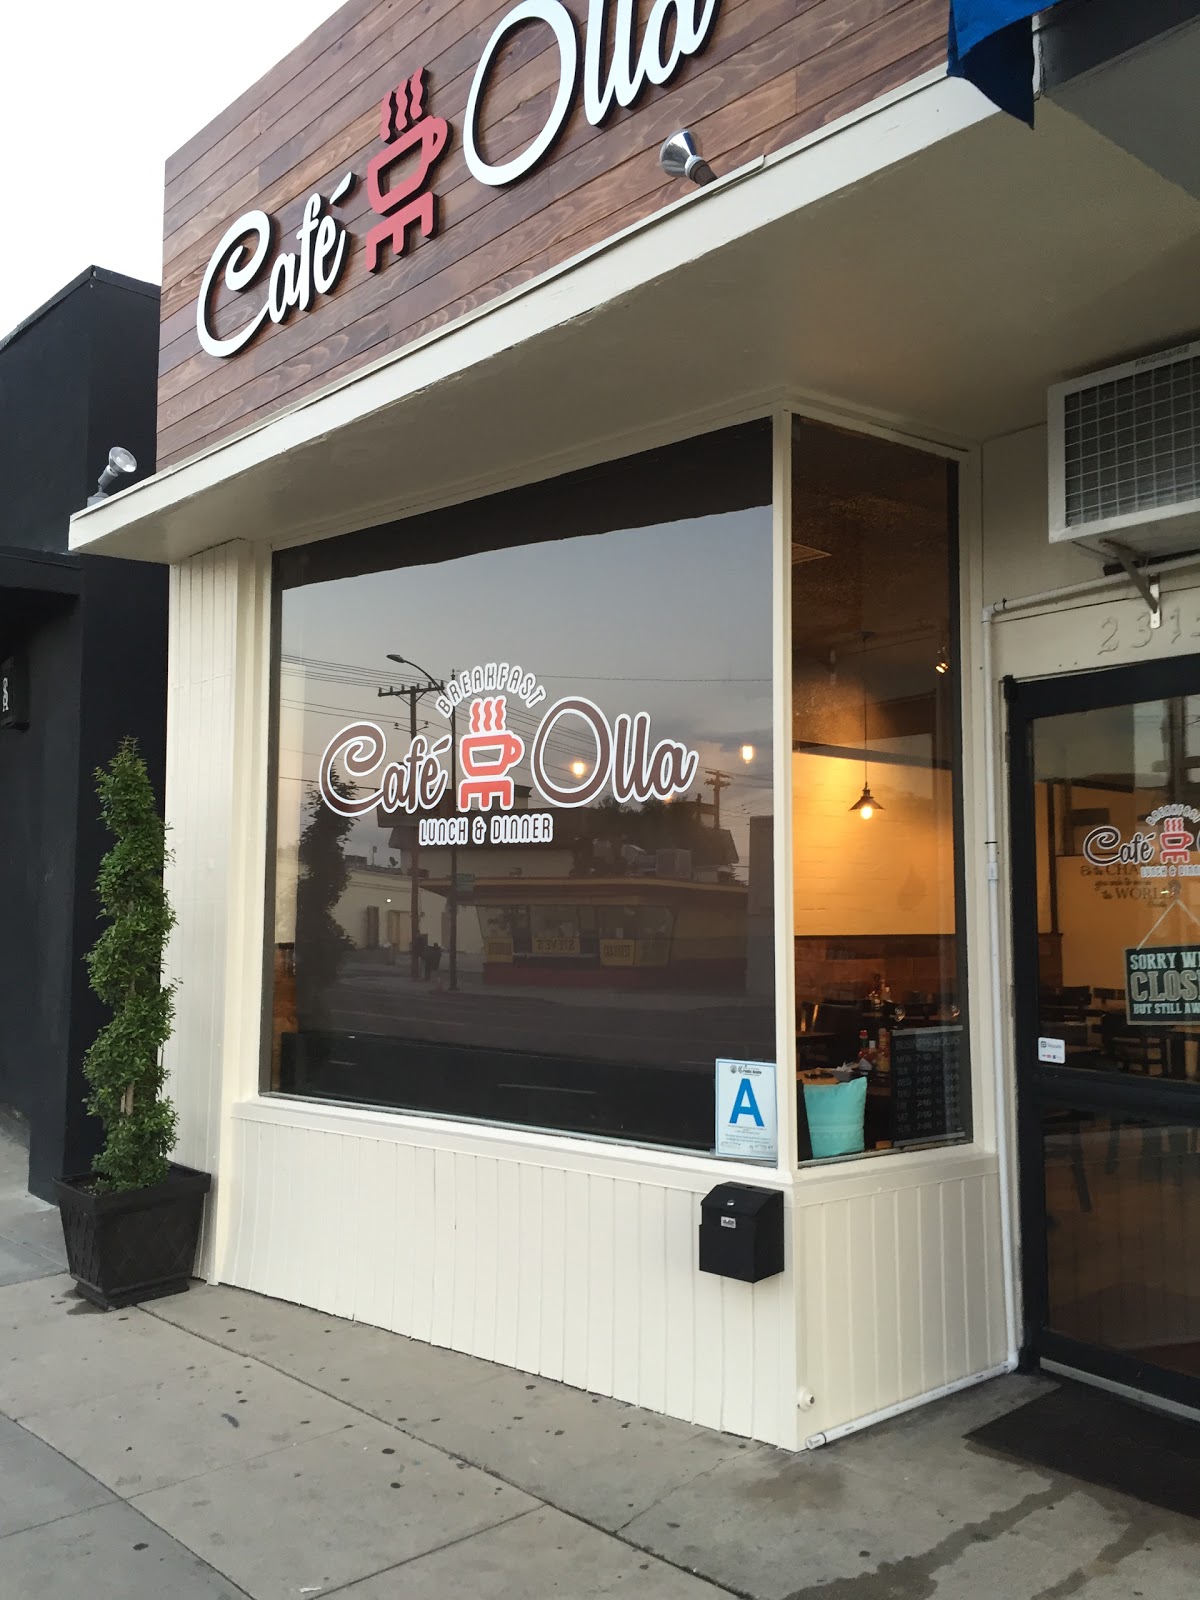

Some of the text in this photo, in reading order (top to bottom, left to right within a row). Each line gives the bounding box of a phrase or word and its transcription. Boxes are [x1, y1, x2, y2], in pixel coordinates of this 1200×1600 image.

[197, 0, 715, 358] Café Olla
[435, 662, 547, 718] BREAKFAST
[319, 695, 699, 817] Café Olla
[418, 812, 554, 846] LUNCH & DINNER
[1082, 825, 1157, 867] Café
[1130, 952, 1177, 970] SORRY
[1130, 969, 1200, 1002] CLOS
[1133, 1003, 1153, 1015] BUT
[1154, 1002, 1182, 1015] STILL
[729, 1078, 766, 1127] A
